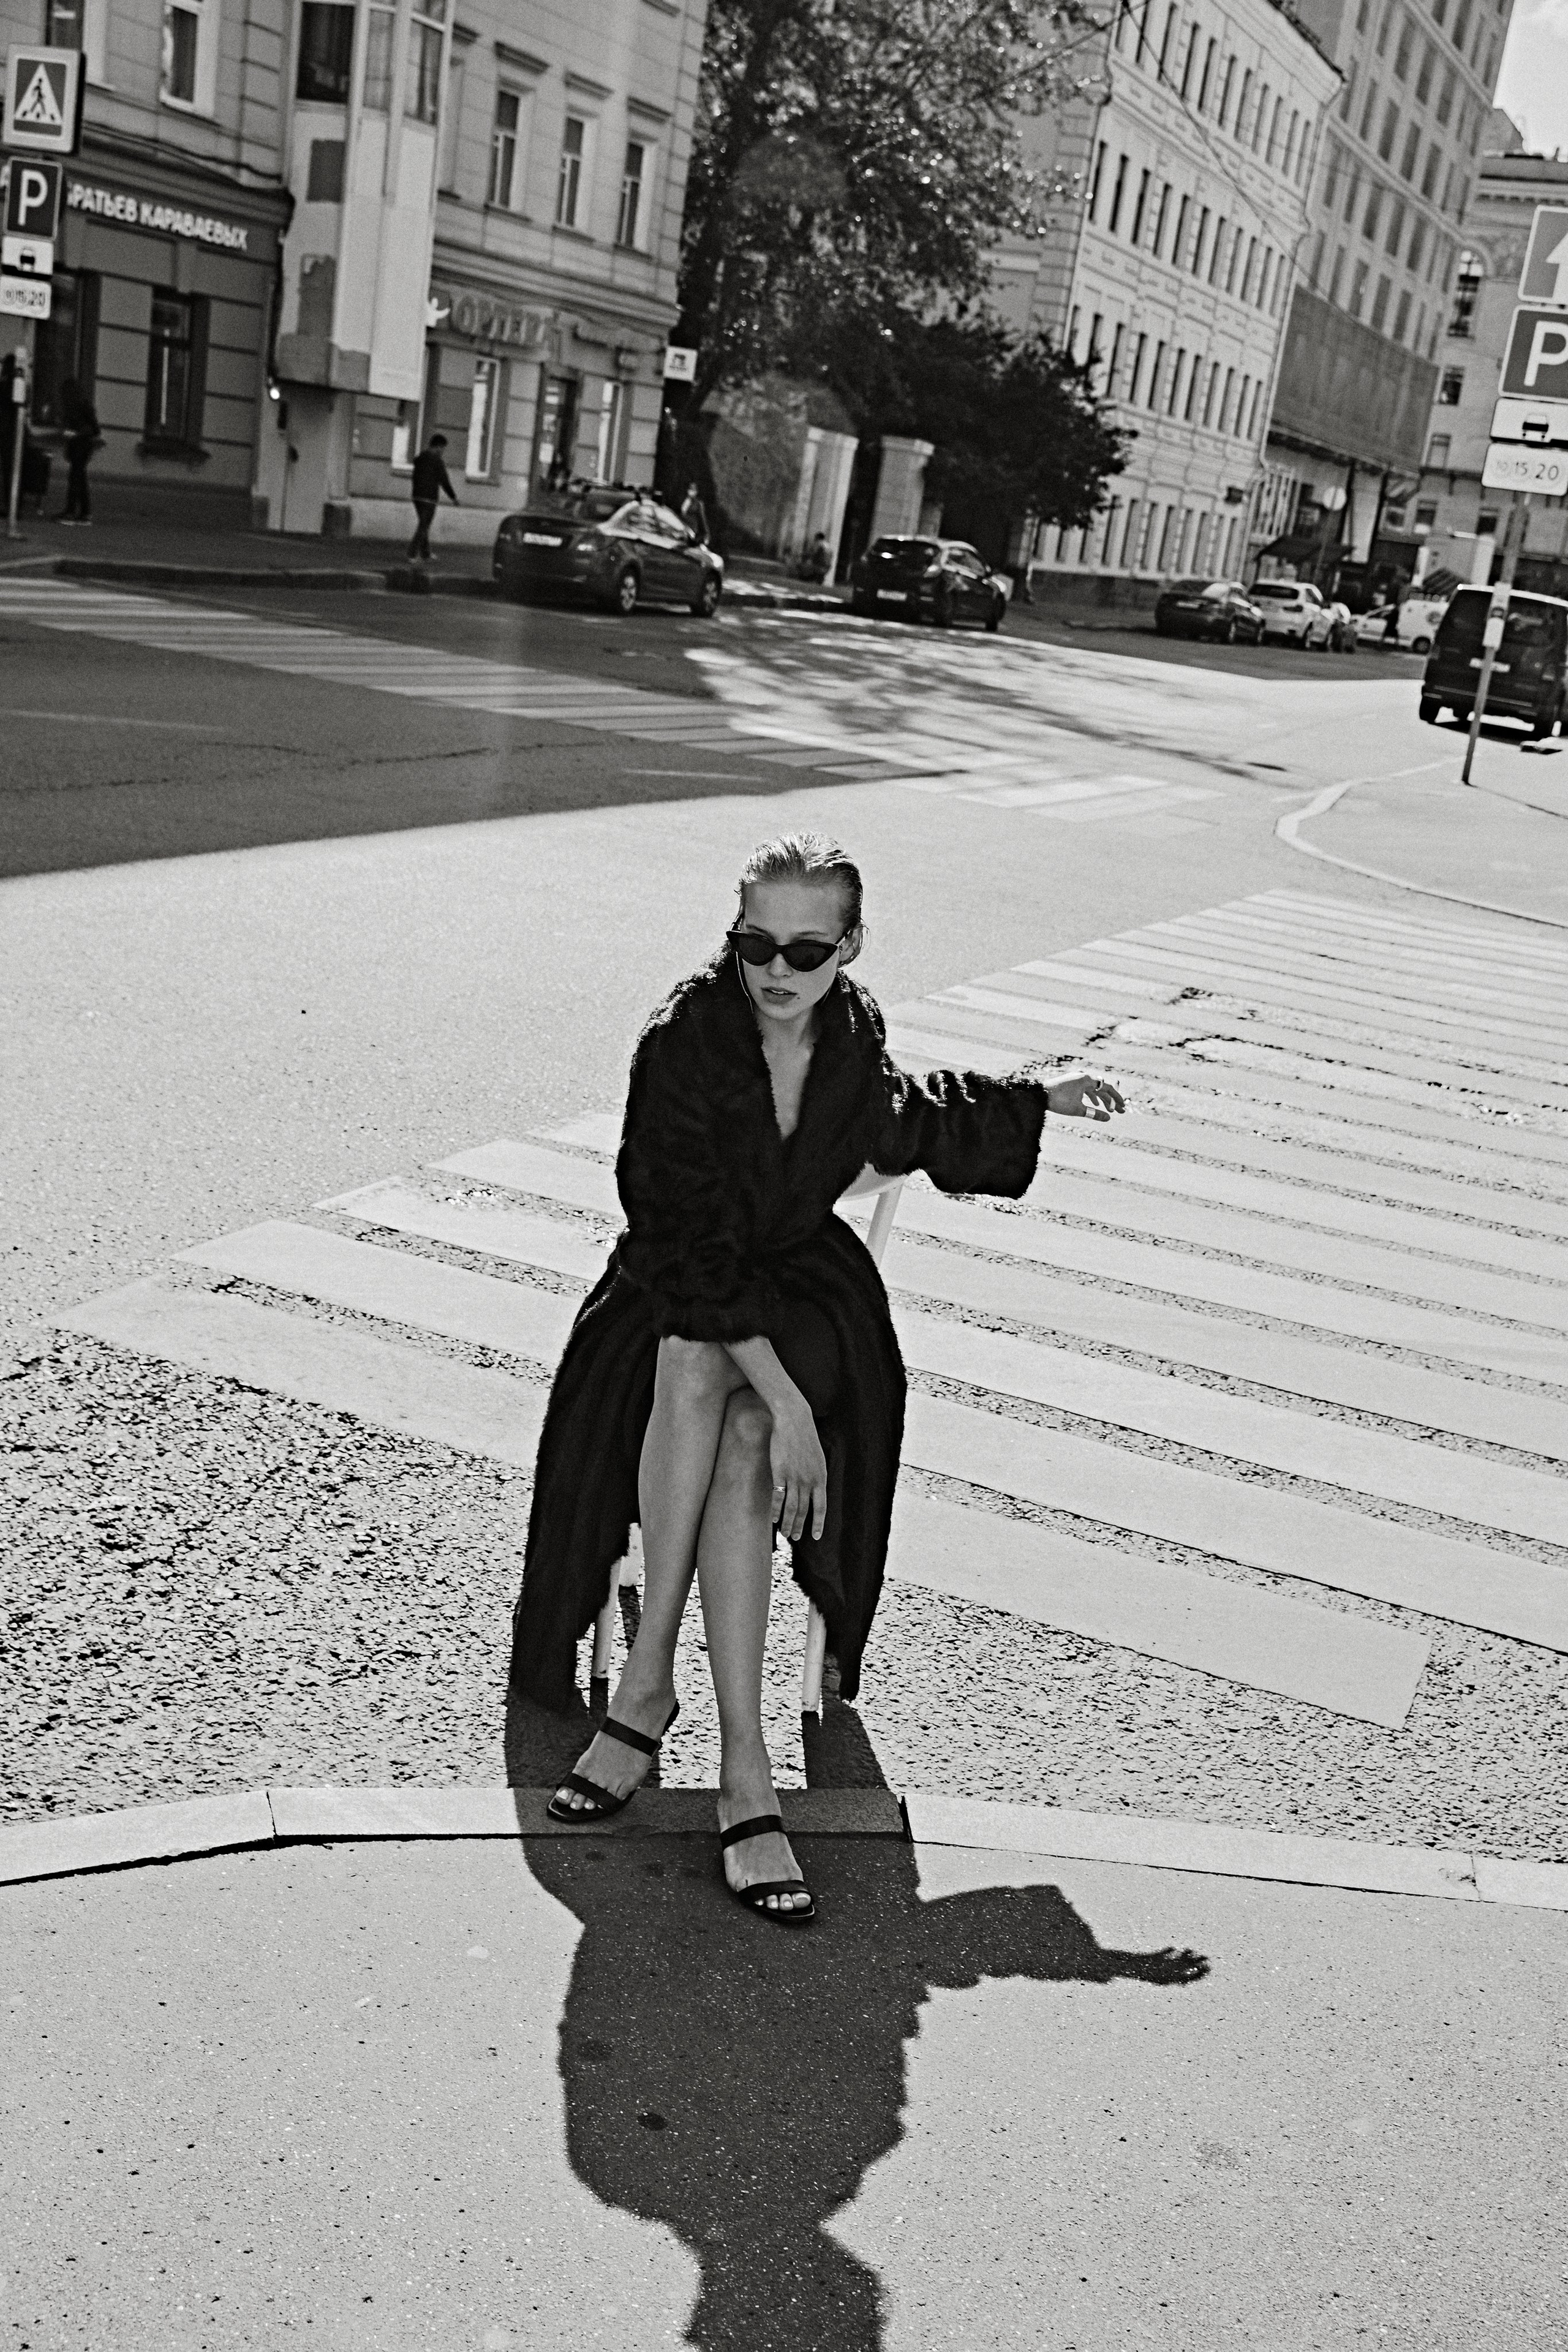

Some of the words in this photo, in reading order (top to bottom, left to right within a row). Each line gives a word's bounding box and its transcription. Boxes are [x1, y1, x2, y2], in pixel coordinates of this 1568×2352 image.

[18, 169, 48, 226] P
[140, 203, 247, 251] КАРАВАЕВЫХ
[1523, 320, 1568, 386] P
[1535, 463, 1559, 481] 20
